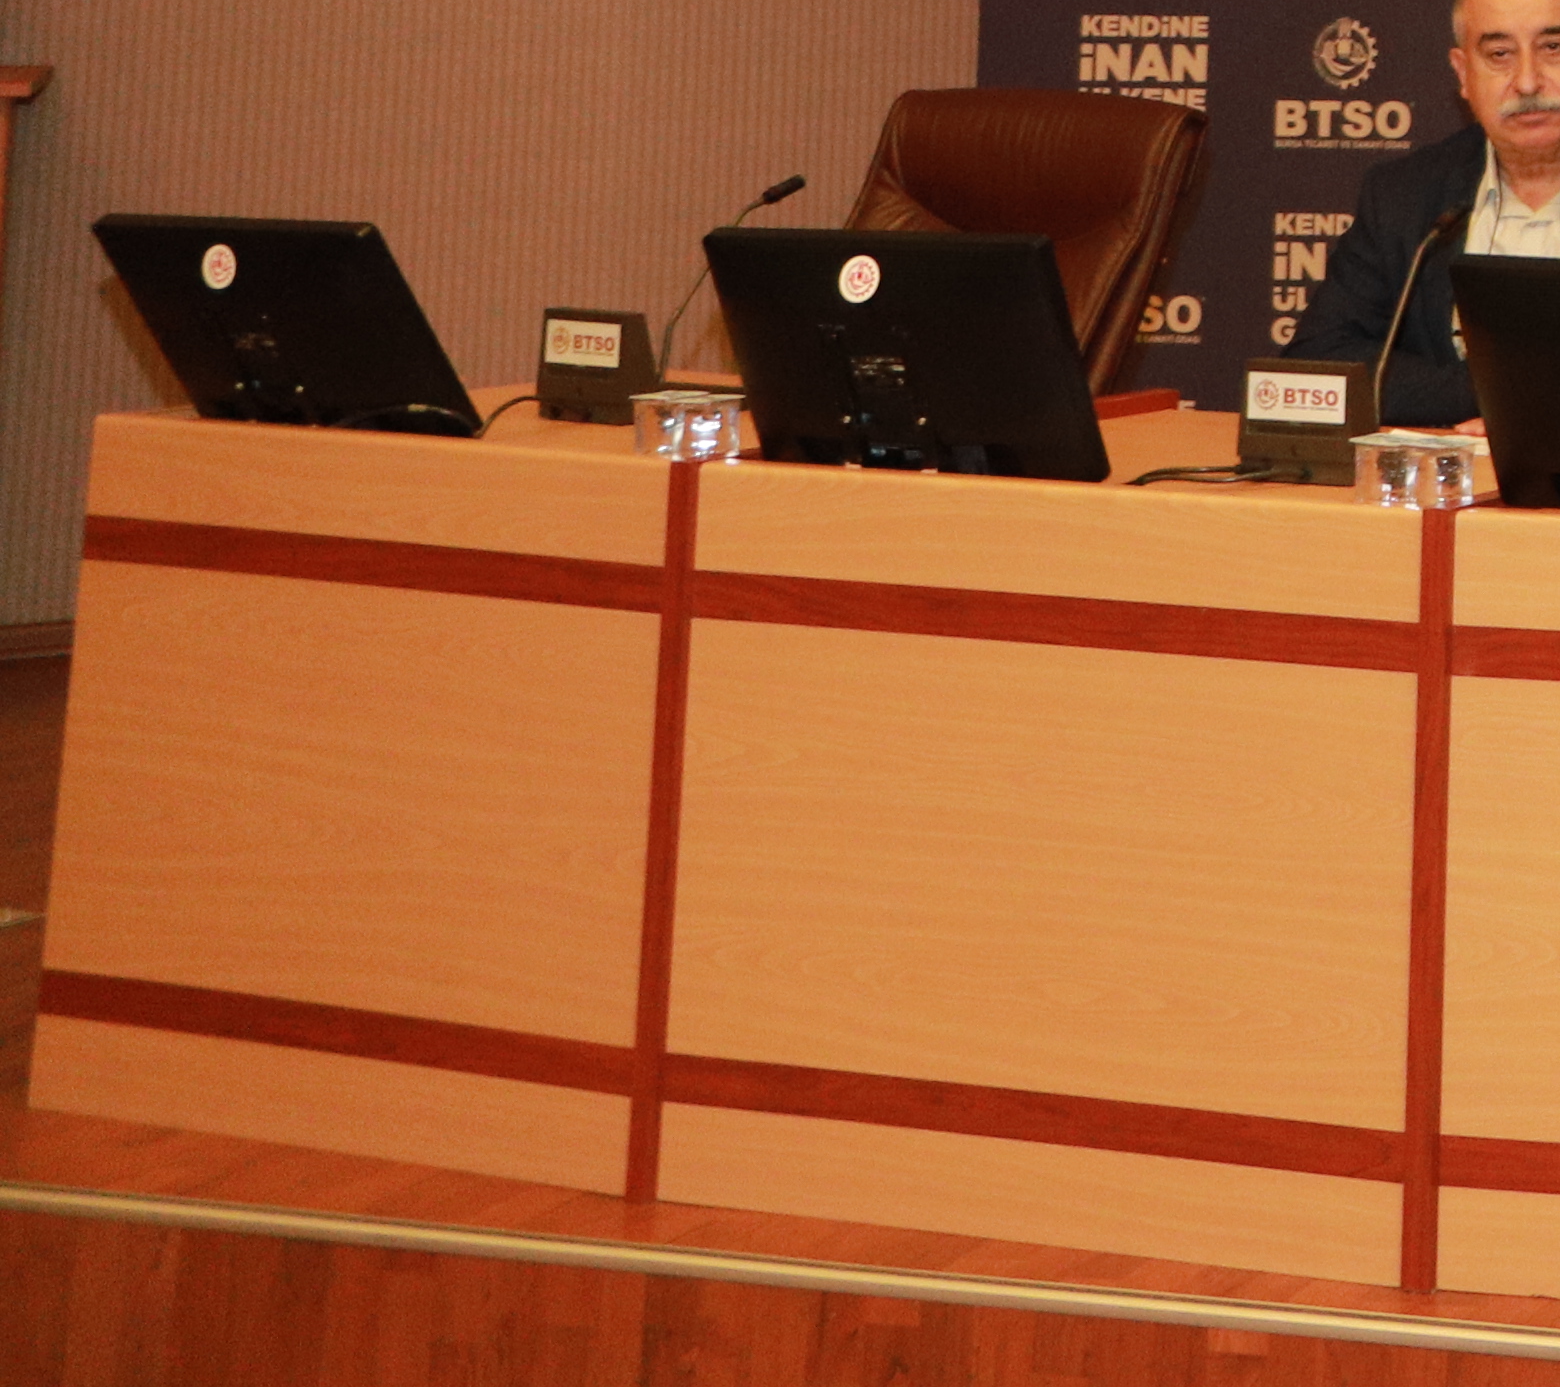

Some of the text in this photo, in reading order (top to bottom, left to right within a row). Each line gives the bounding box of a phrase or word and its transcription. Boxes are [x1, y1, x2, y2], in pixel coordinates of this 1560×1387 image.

[1274, 100, 1411, 139] BTSO
[574, 334, 615, 352] BTSO
[1284, 388, 1339, 406] BTSO
